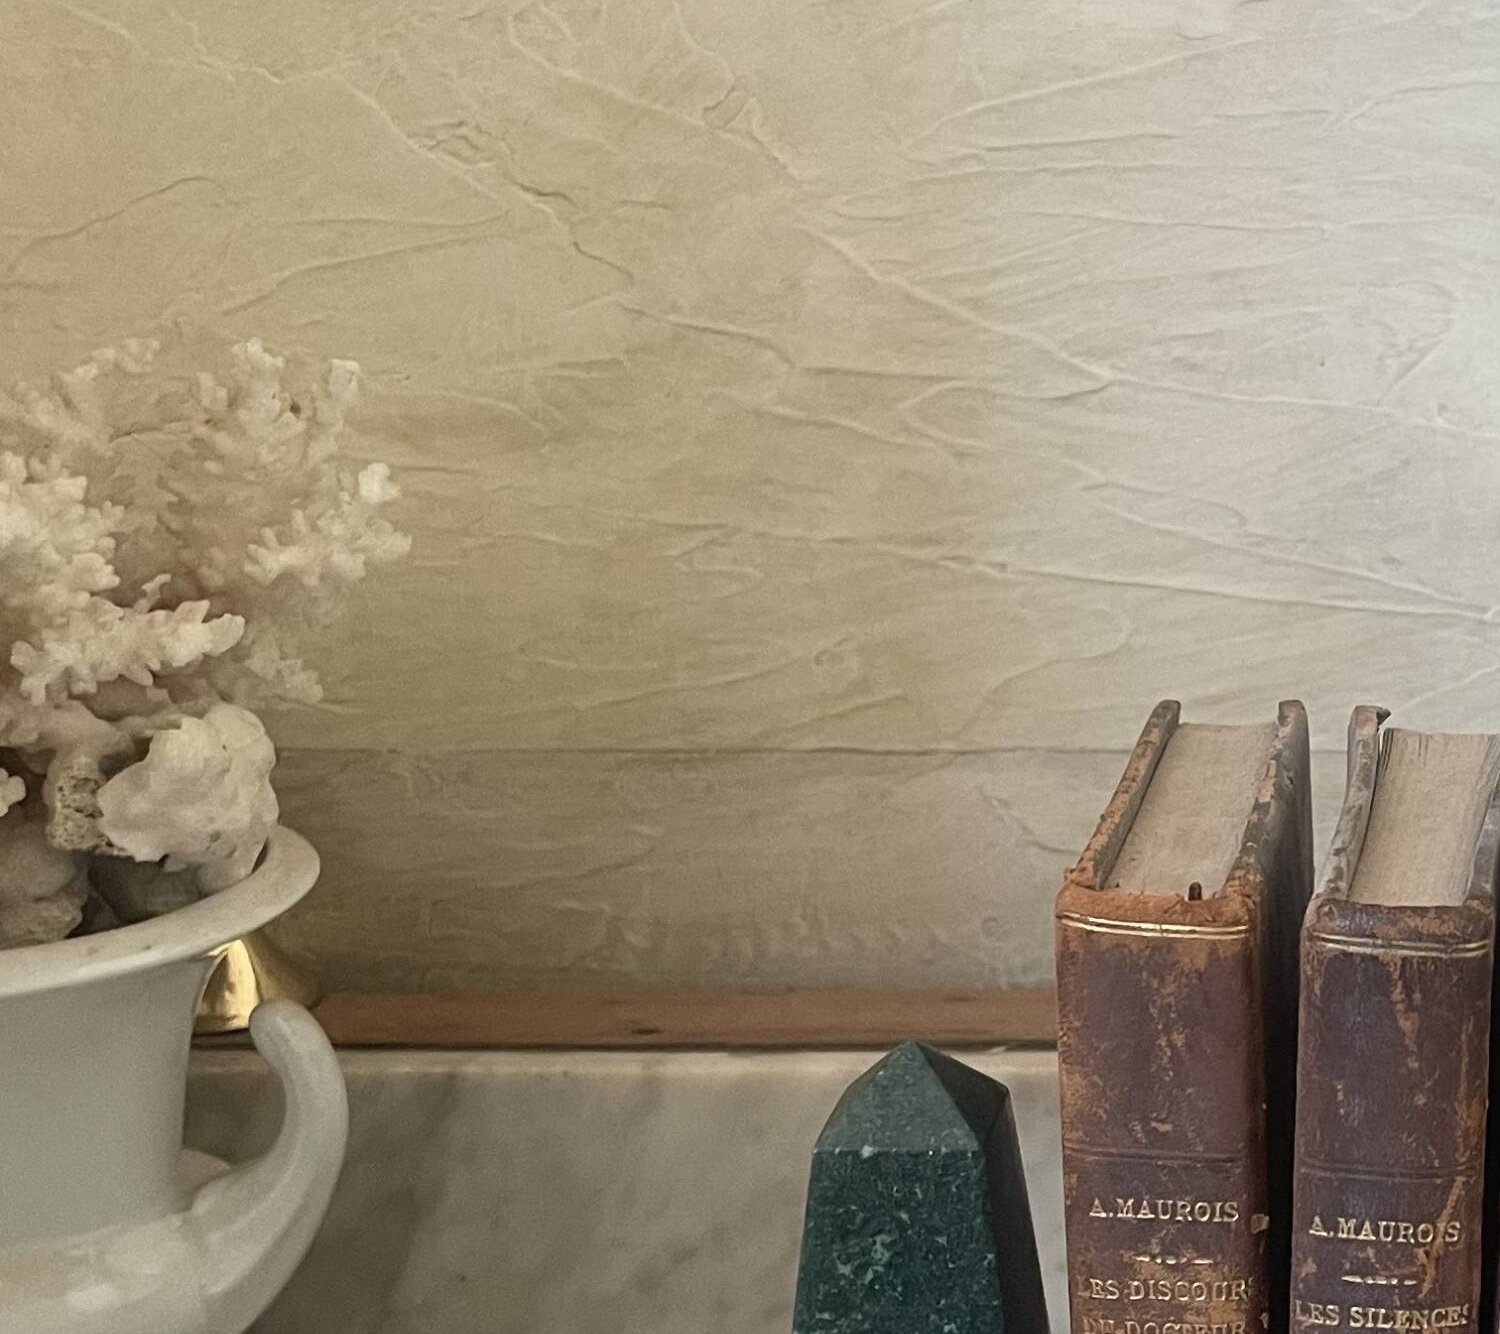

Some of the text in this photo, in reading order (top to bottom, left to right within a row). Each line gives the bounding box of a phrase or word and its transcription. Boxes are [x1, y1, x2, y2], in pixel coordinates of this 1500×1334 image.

[1089, 1198, 1240, 1224] A.MAUROIS
[1309, 1215, 1462, 1244] A.MAUROIS
[1128, 1276, 1254, 1302] DISCOUR
[1294, 1299, 1341, 1327] LES
